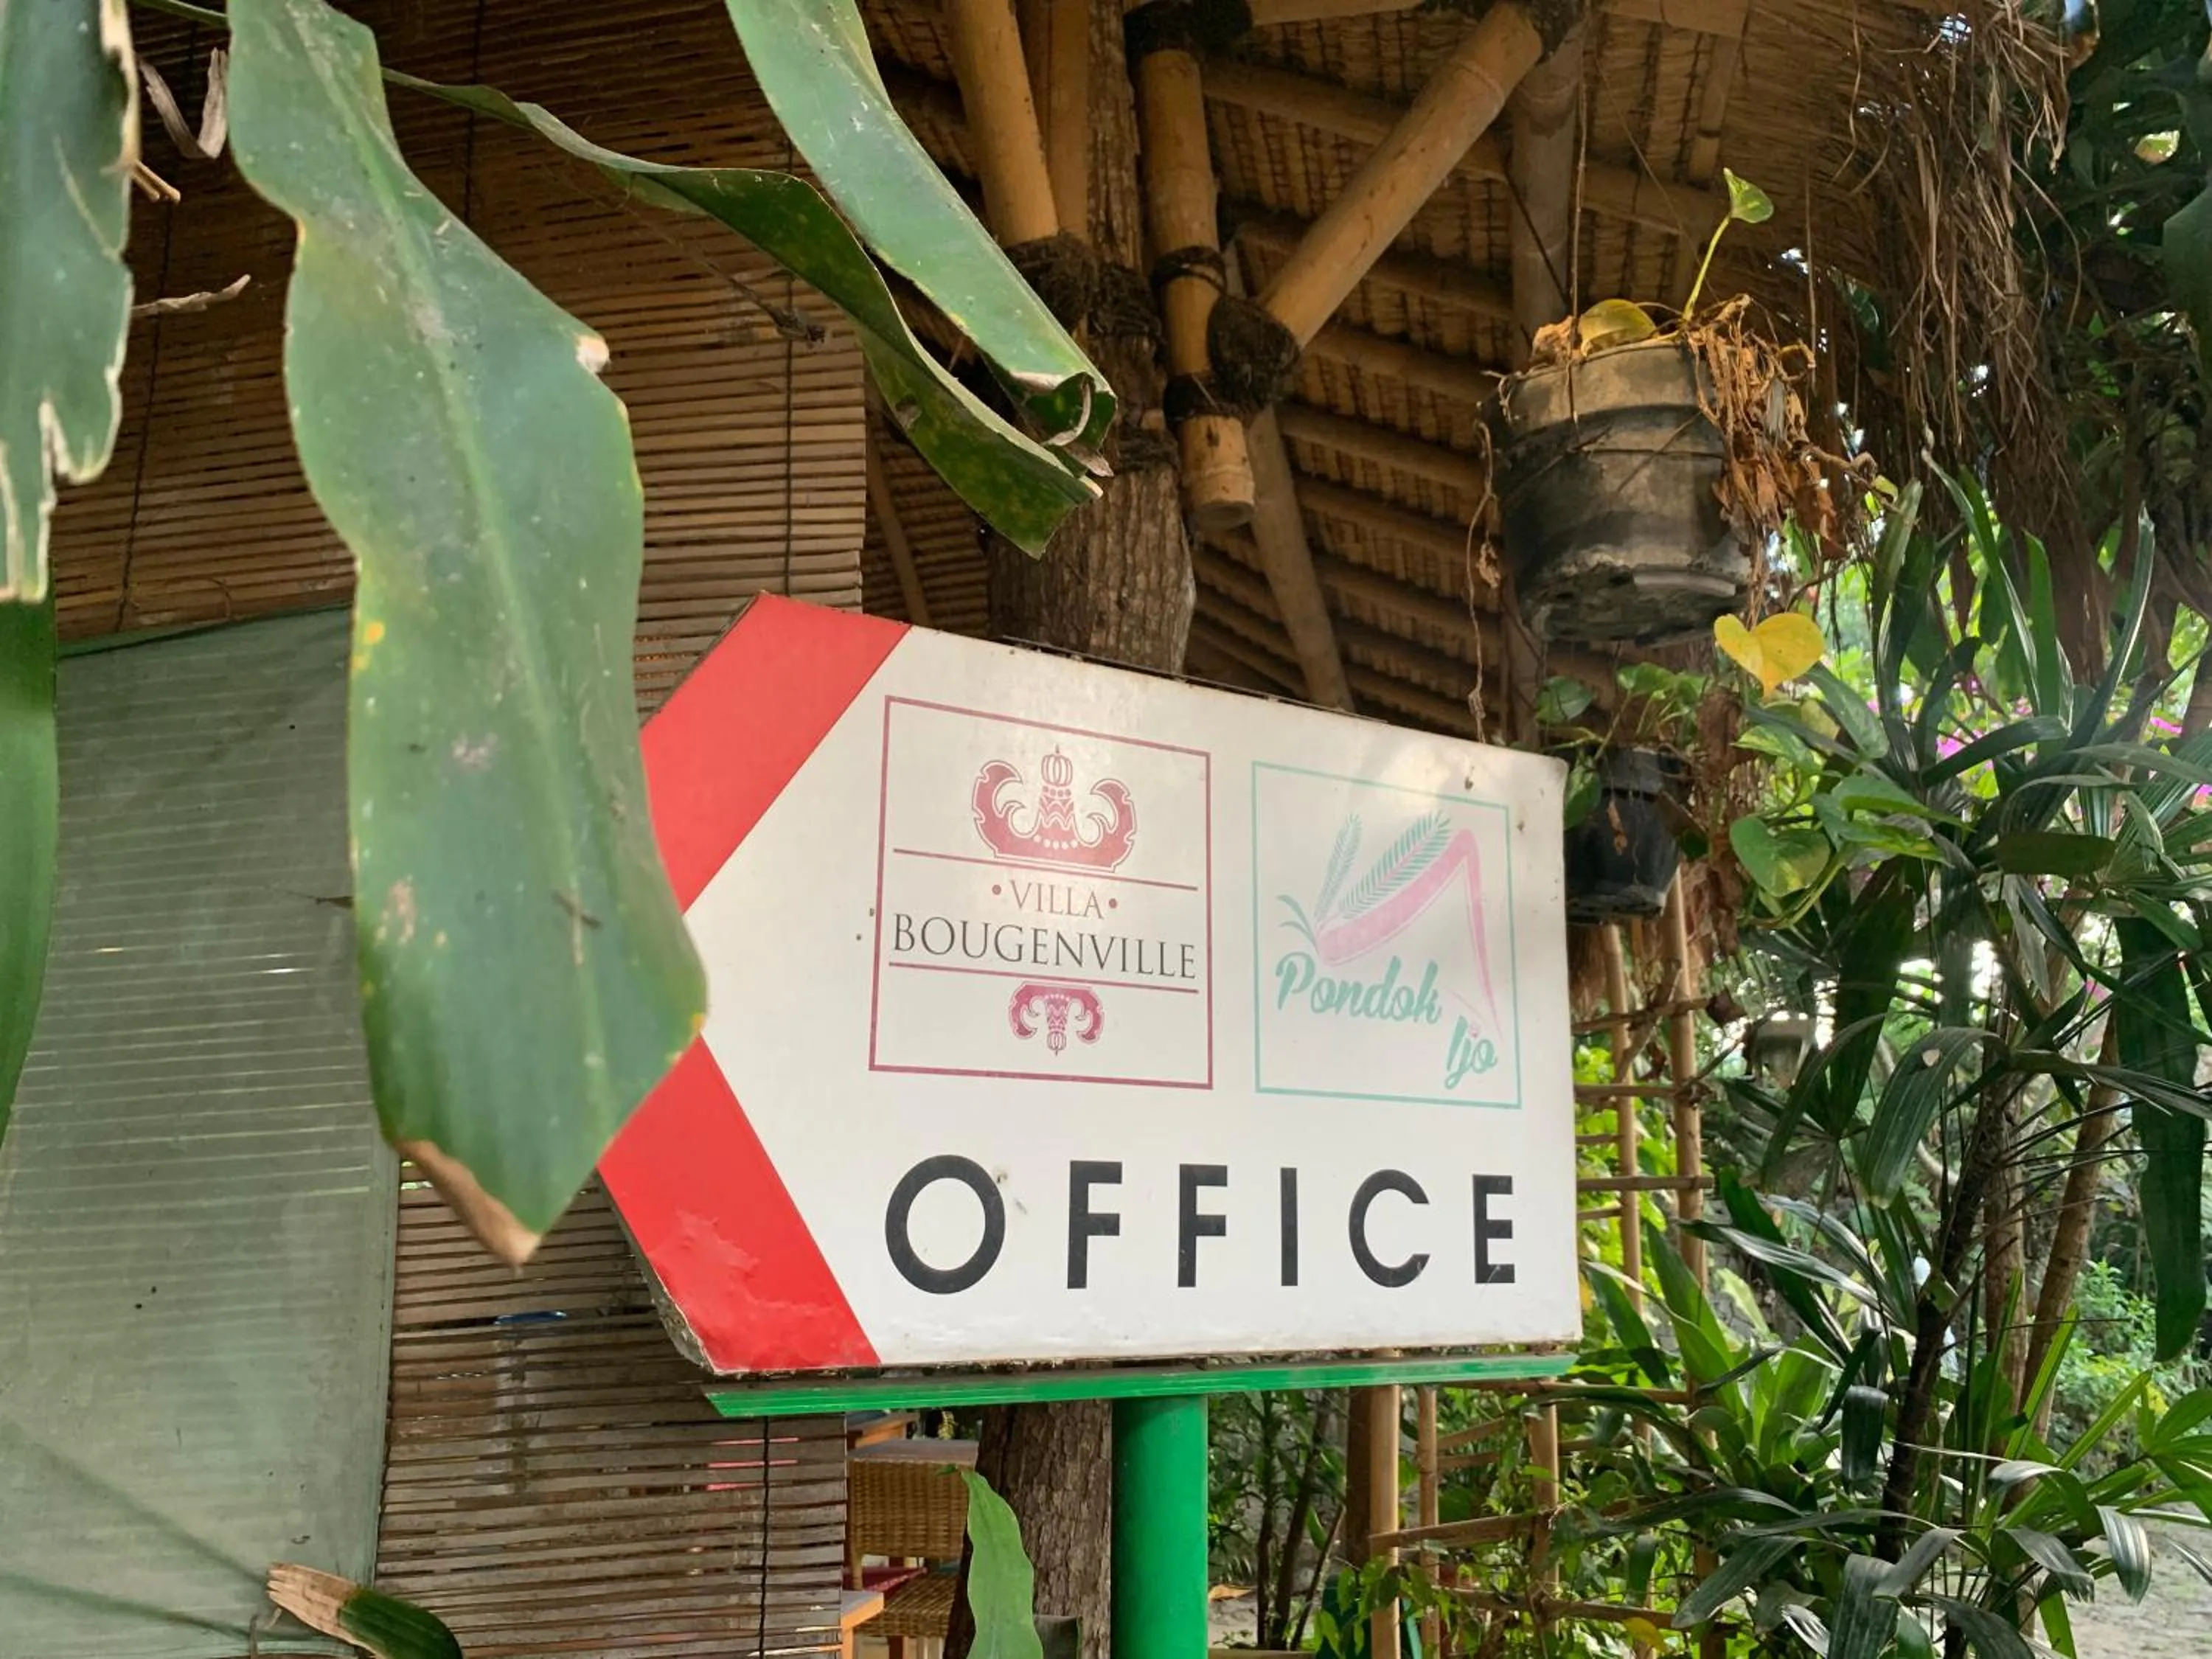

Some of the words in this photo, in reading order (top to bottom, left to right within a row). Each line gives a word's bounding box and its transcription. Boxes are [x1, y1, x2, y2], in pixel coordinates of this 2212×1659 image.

[1010, 880, 1105, 920] VILLA
[893, 912, 1196, 980] BOUGENVILLE
[1276, 951, 1443, 1025] Pondok
[1444, 1015, 1498, 1091] Ijo
[885, 1154, 1516, 1295] OFFICE
